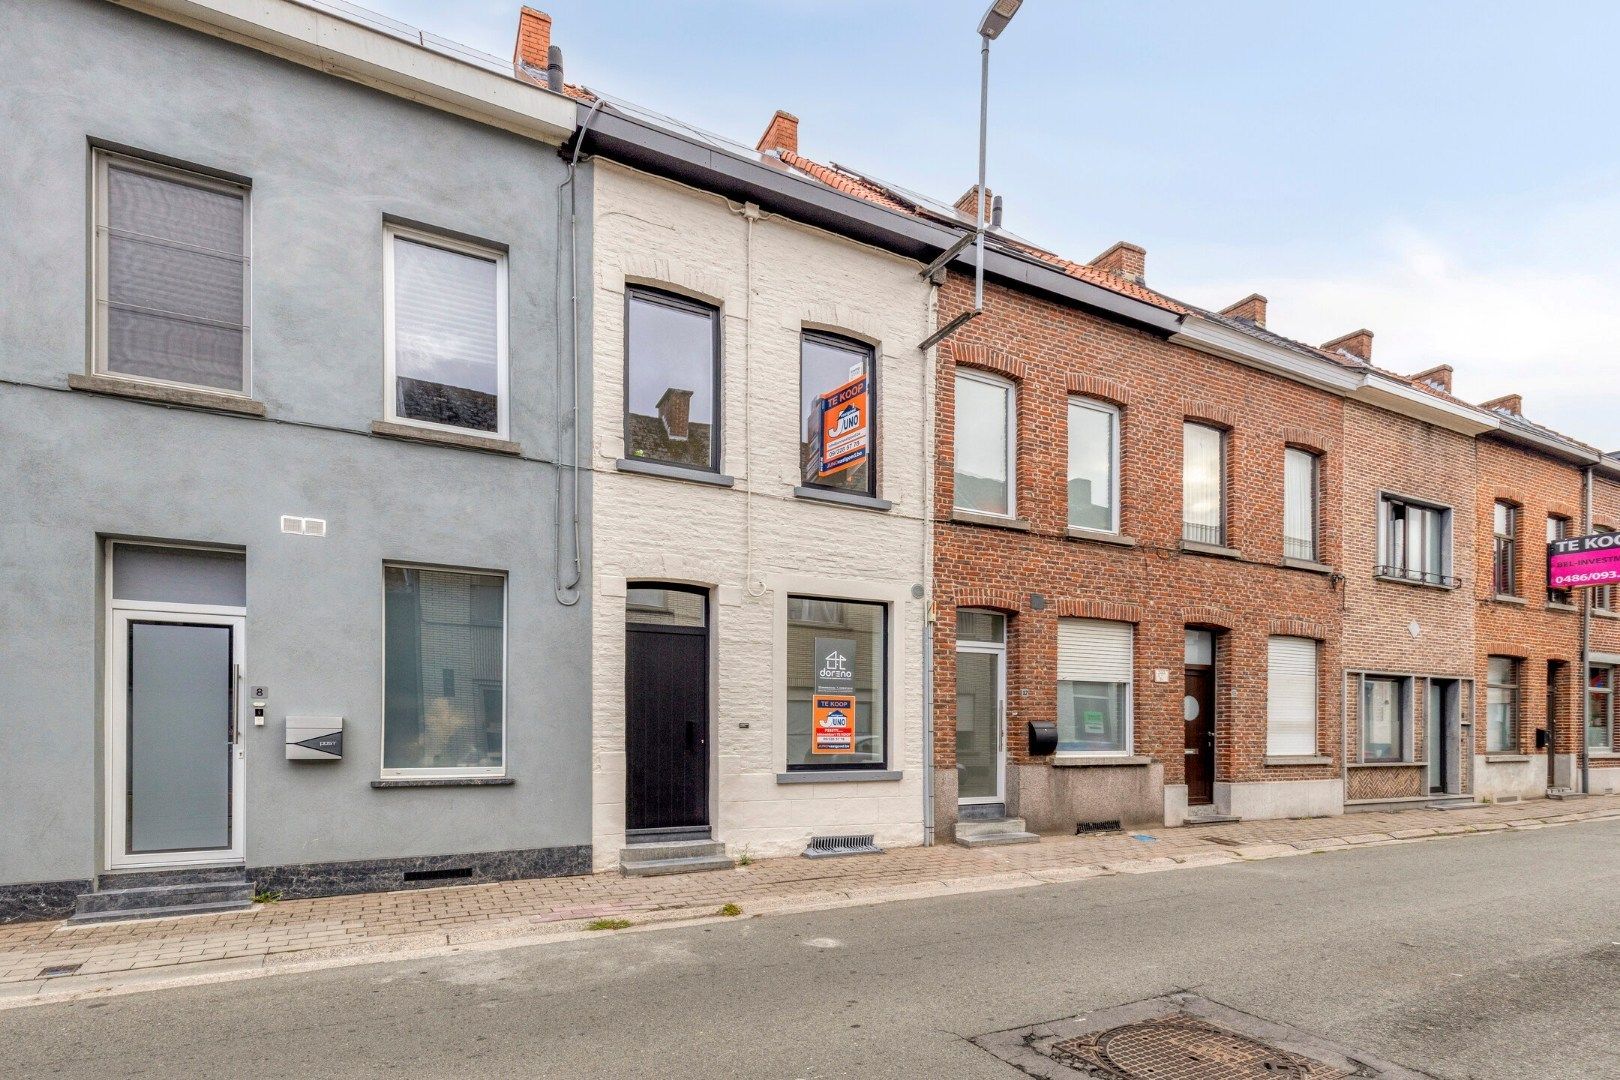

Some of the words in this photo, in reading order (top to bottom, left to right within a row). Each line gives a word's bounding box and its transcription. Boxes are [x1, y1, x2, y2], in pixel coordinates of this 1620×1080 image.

[828, 395, 838, 408] TE
[839, 382, 864, 402] KOOP
[828, 410, 859, 438] JUNO
[1555, 539, 1580, 553] TE
[256, 688, 263, 697] 8
